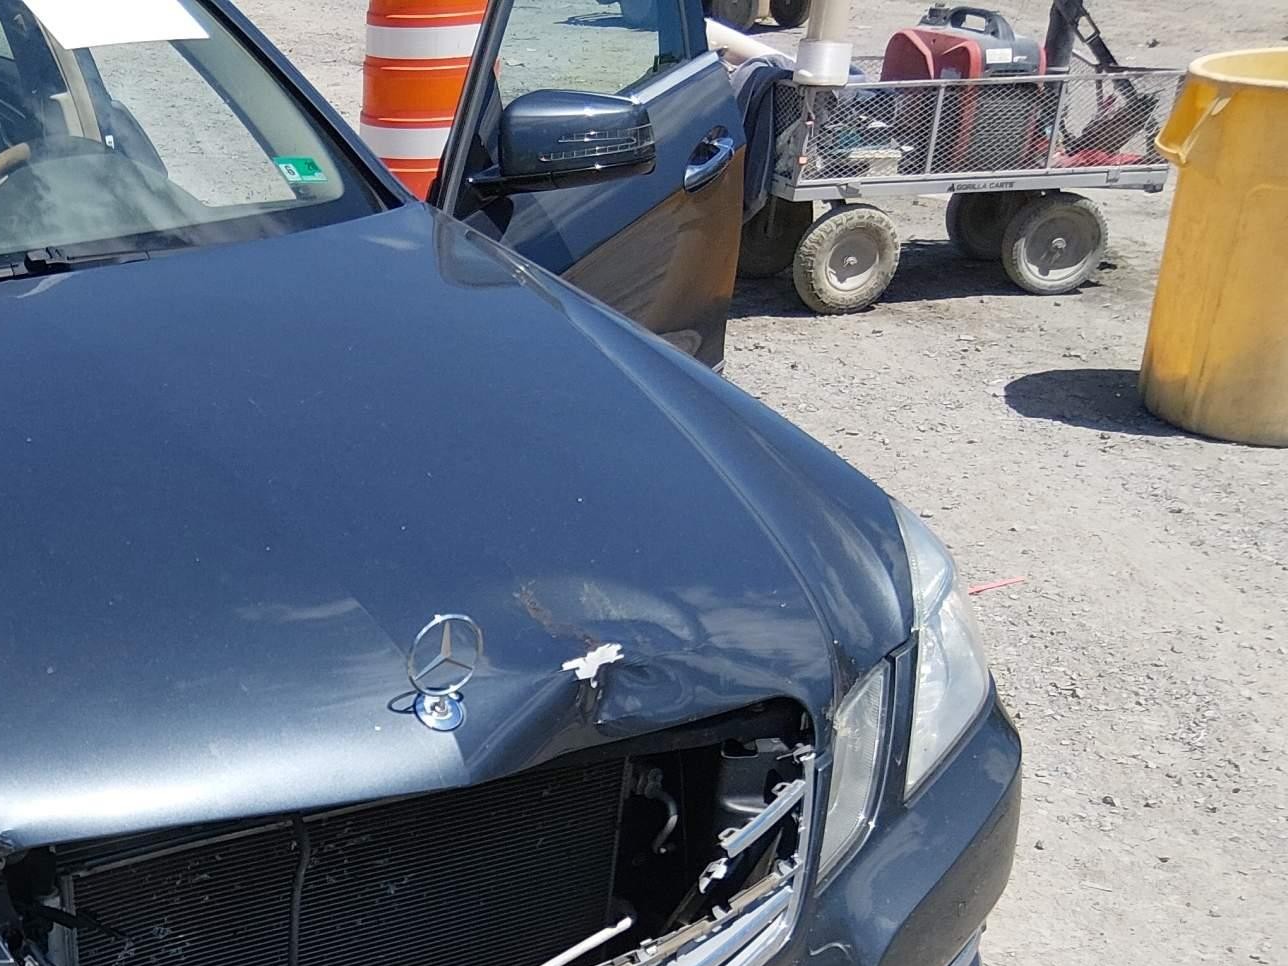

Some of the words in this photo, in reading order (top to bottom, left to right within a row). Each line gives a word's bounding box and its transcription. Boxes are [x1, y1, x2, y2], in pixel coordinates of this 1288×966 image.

[284, 165, 296, 176] 6
[956, 183, 987, 191] GORILLA
[989, 181, 1016, 189] CARTS
